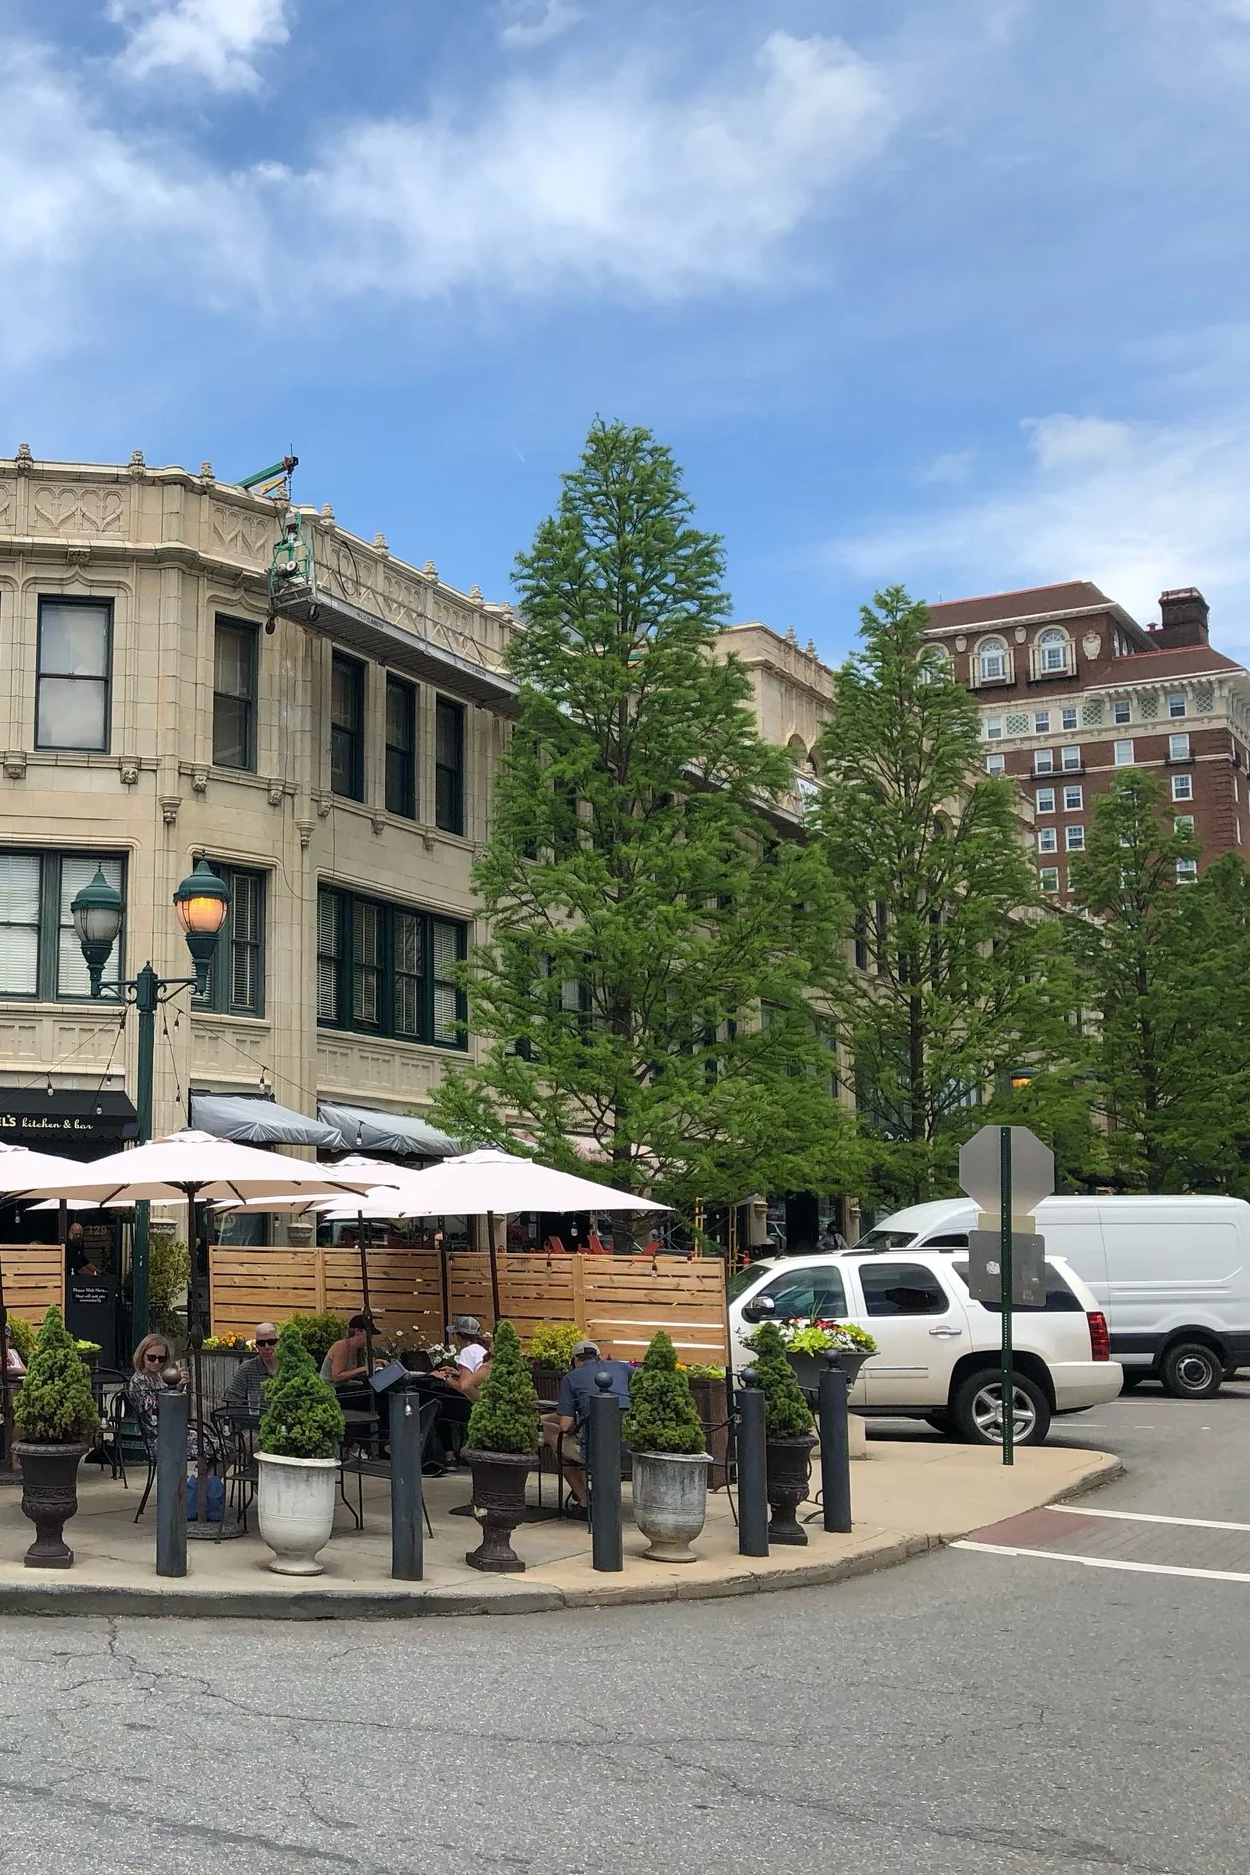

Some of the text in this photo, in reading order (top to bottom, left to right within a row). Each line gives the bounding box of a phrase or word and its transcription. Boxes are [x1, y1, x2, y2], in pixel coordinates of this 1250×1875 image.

[22, 1116, 62, 1128] kitchen
[63, 1119, 72, 1129] &
[74, 1119, 94, 1129] bar
[88, 1225, 107, 1236] 129
